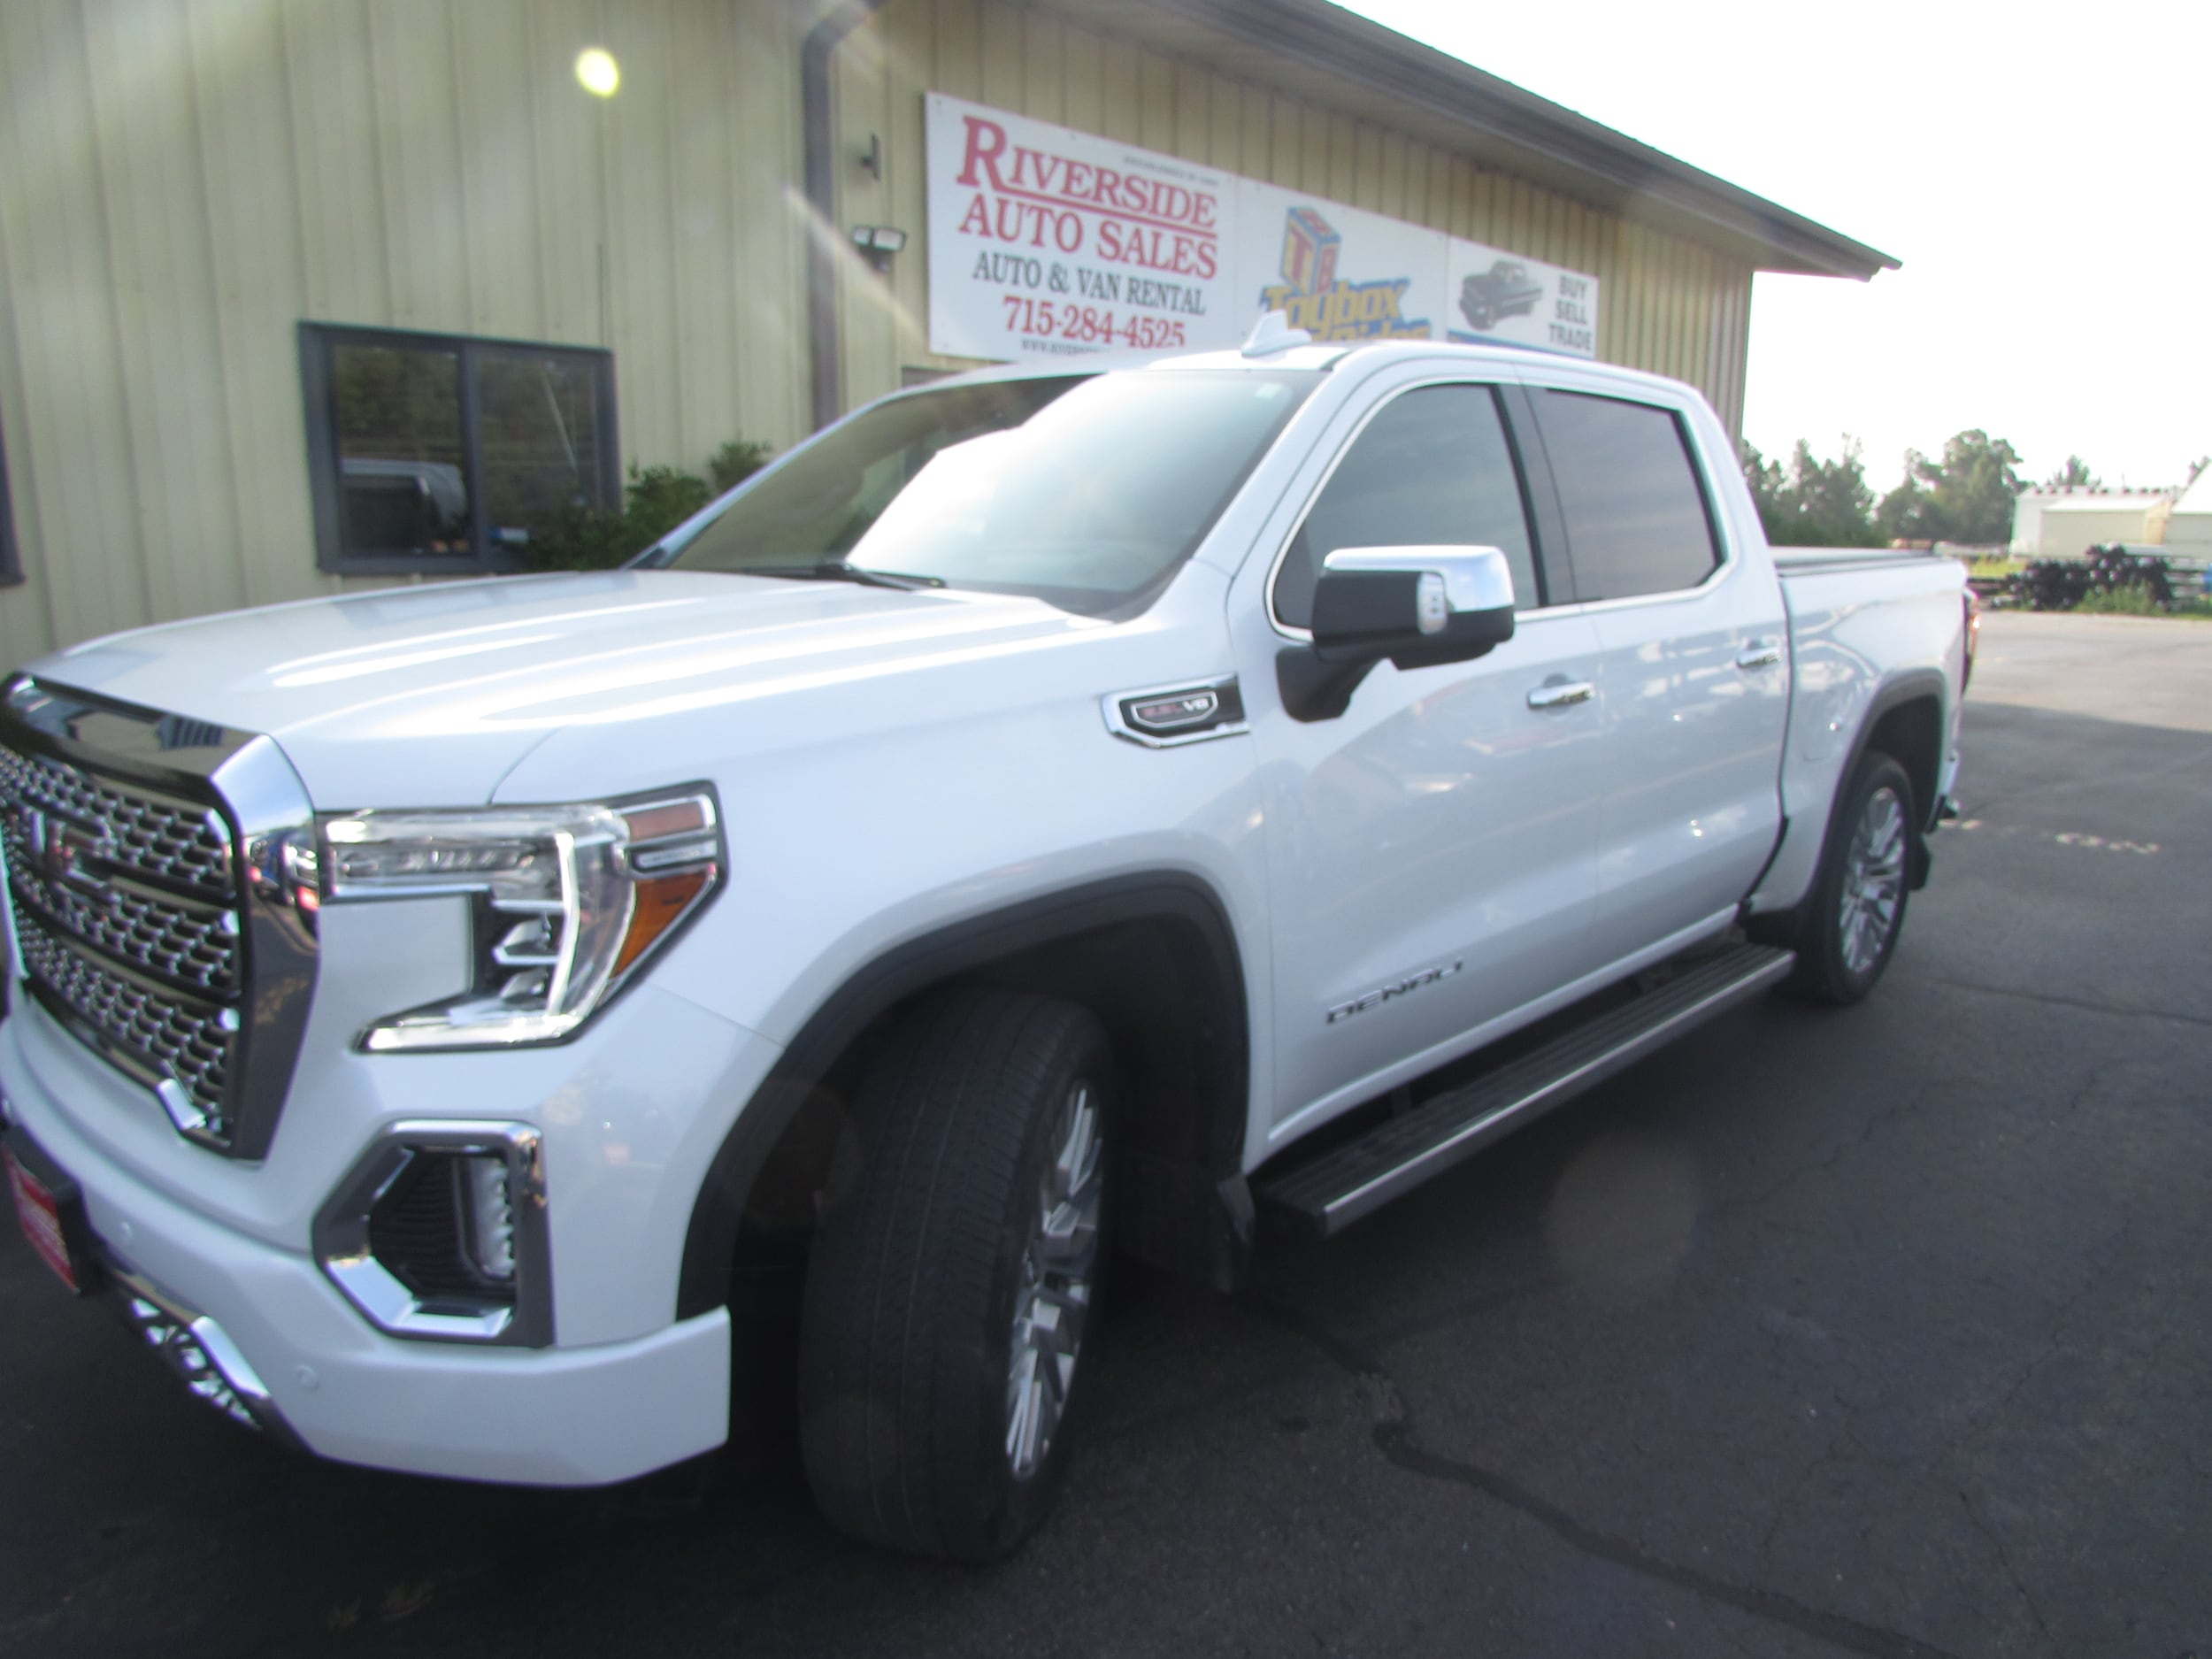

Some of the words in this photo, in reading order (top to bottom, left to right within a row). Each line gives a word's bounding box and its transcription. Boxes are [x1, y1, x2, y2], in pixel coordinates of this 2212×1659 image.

[956, 114, 1218, 230] RIVERSIDE
[958, 192, 1084, 254] AUTO
[1095, 219, 1219, 280] SALES
[972, 250, 1042, 290] AUTO
[1048, 261, 1071, 295] &
[1077, 267, 1122, 302] VAN
[1125, 276, 1208, 317] RENTAL
[1555, 298, 1588, 326] SELL
[1559, 274, 1587, 300] BUY
[1002, 295, 1187, 349] 715-284-4525
[1548, 322, 1592, 352] TRADE
[1325, 956, 1464, 1025] DENALI
